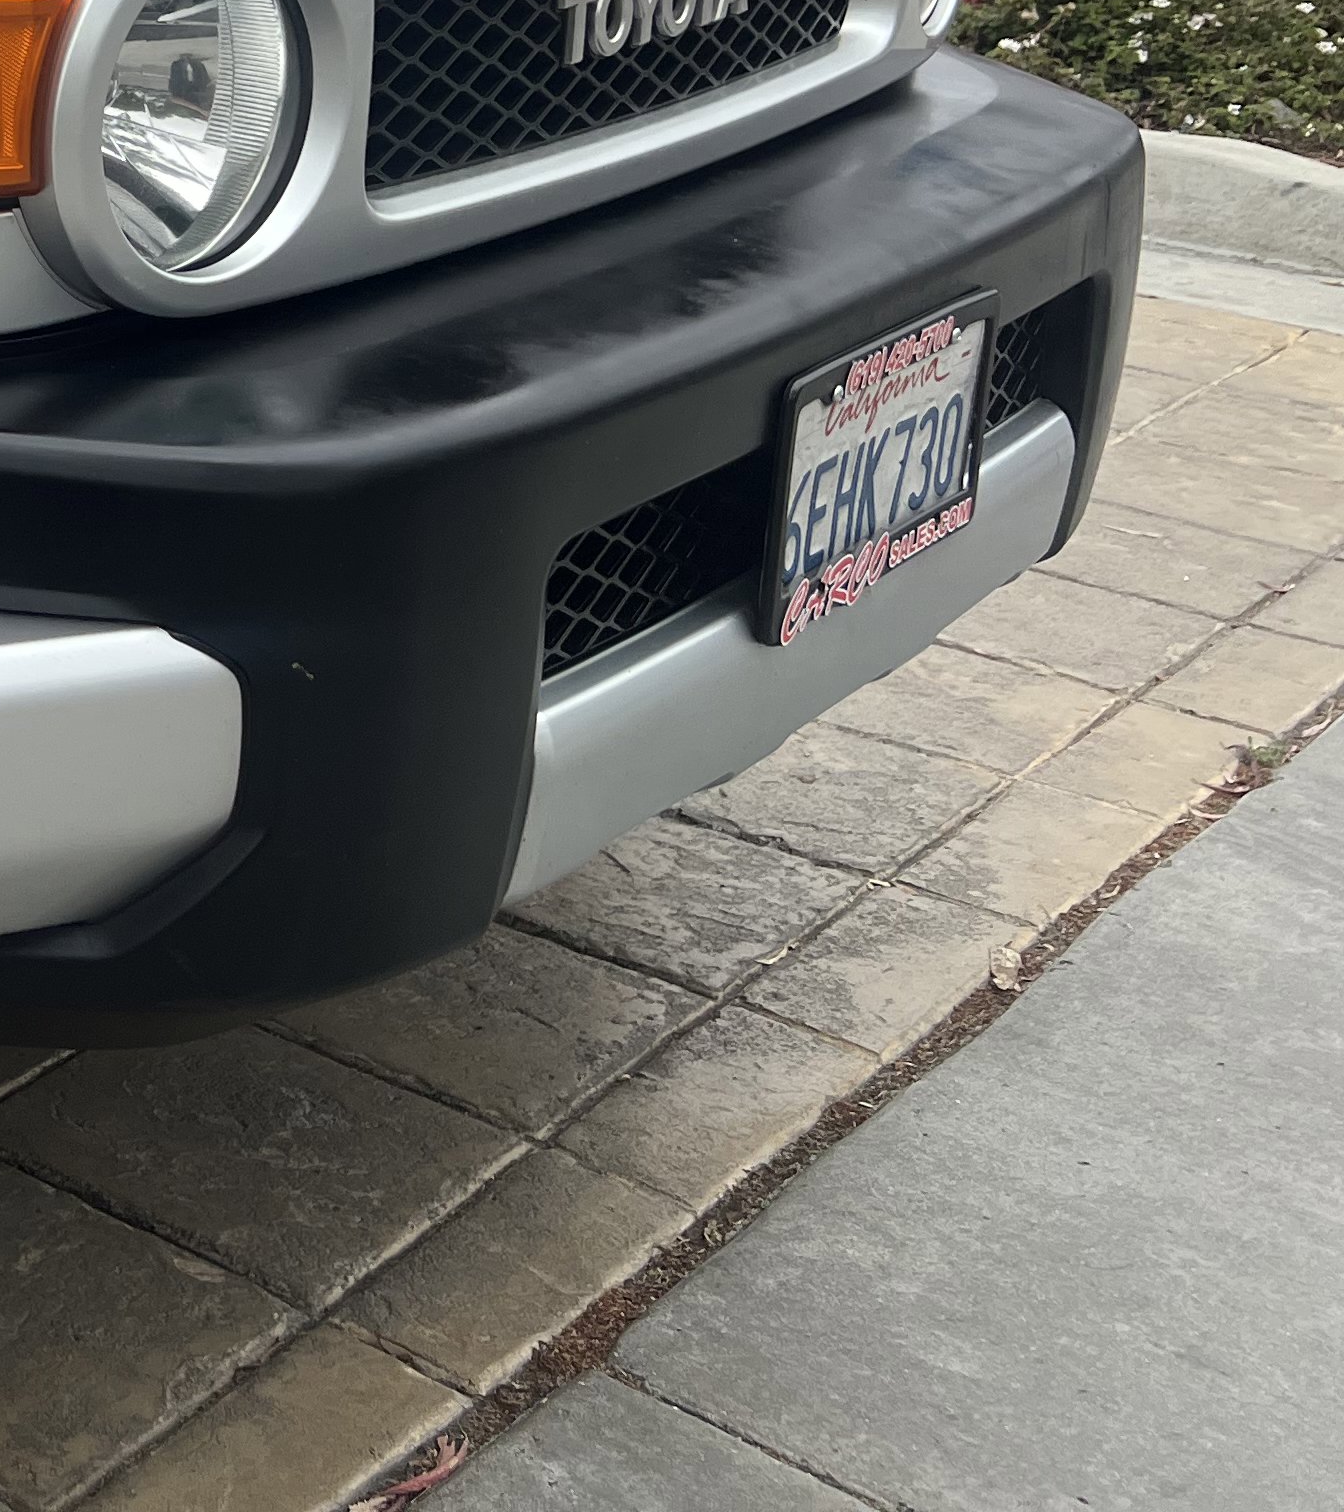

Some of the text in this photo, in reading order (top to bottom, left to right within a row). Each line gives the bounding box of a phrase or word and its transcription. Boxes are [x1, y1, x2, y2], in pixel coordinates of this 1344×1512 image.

[825, 356, 950, 436] California
[844, 315, 955, 399] (619) 420-5700
[783, 392, 963, 584] 6EHK730
[889, 497, 973, 569] SALES.COM
